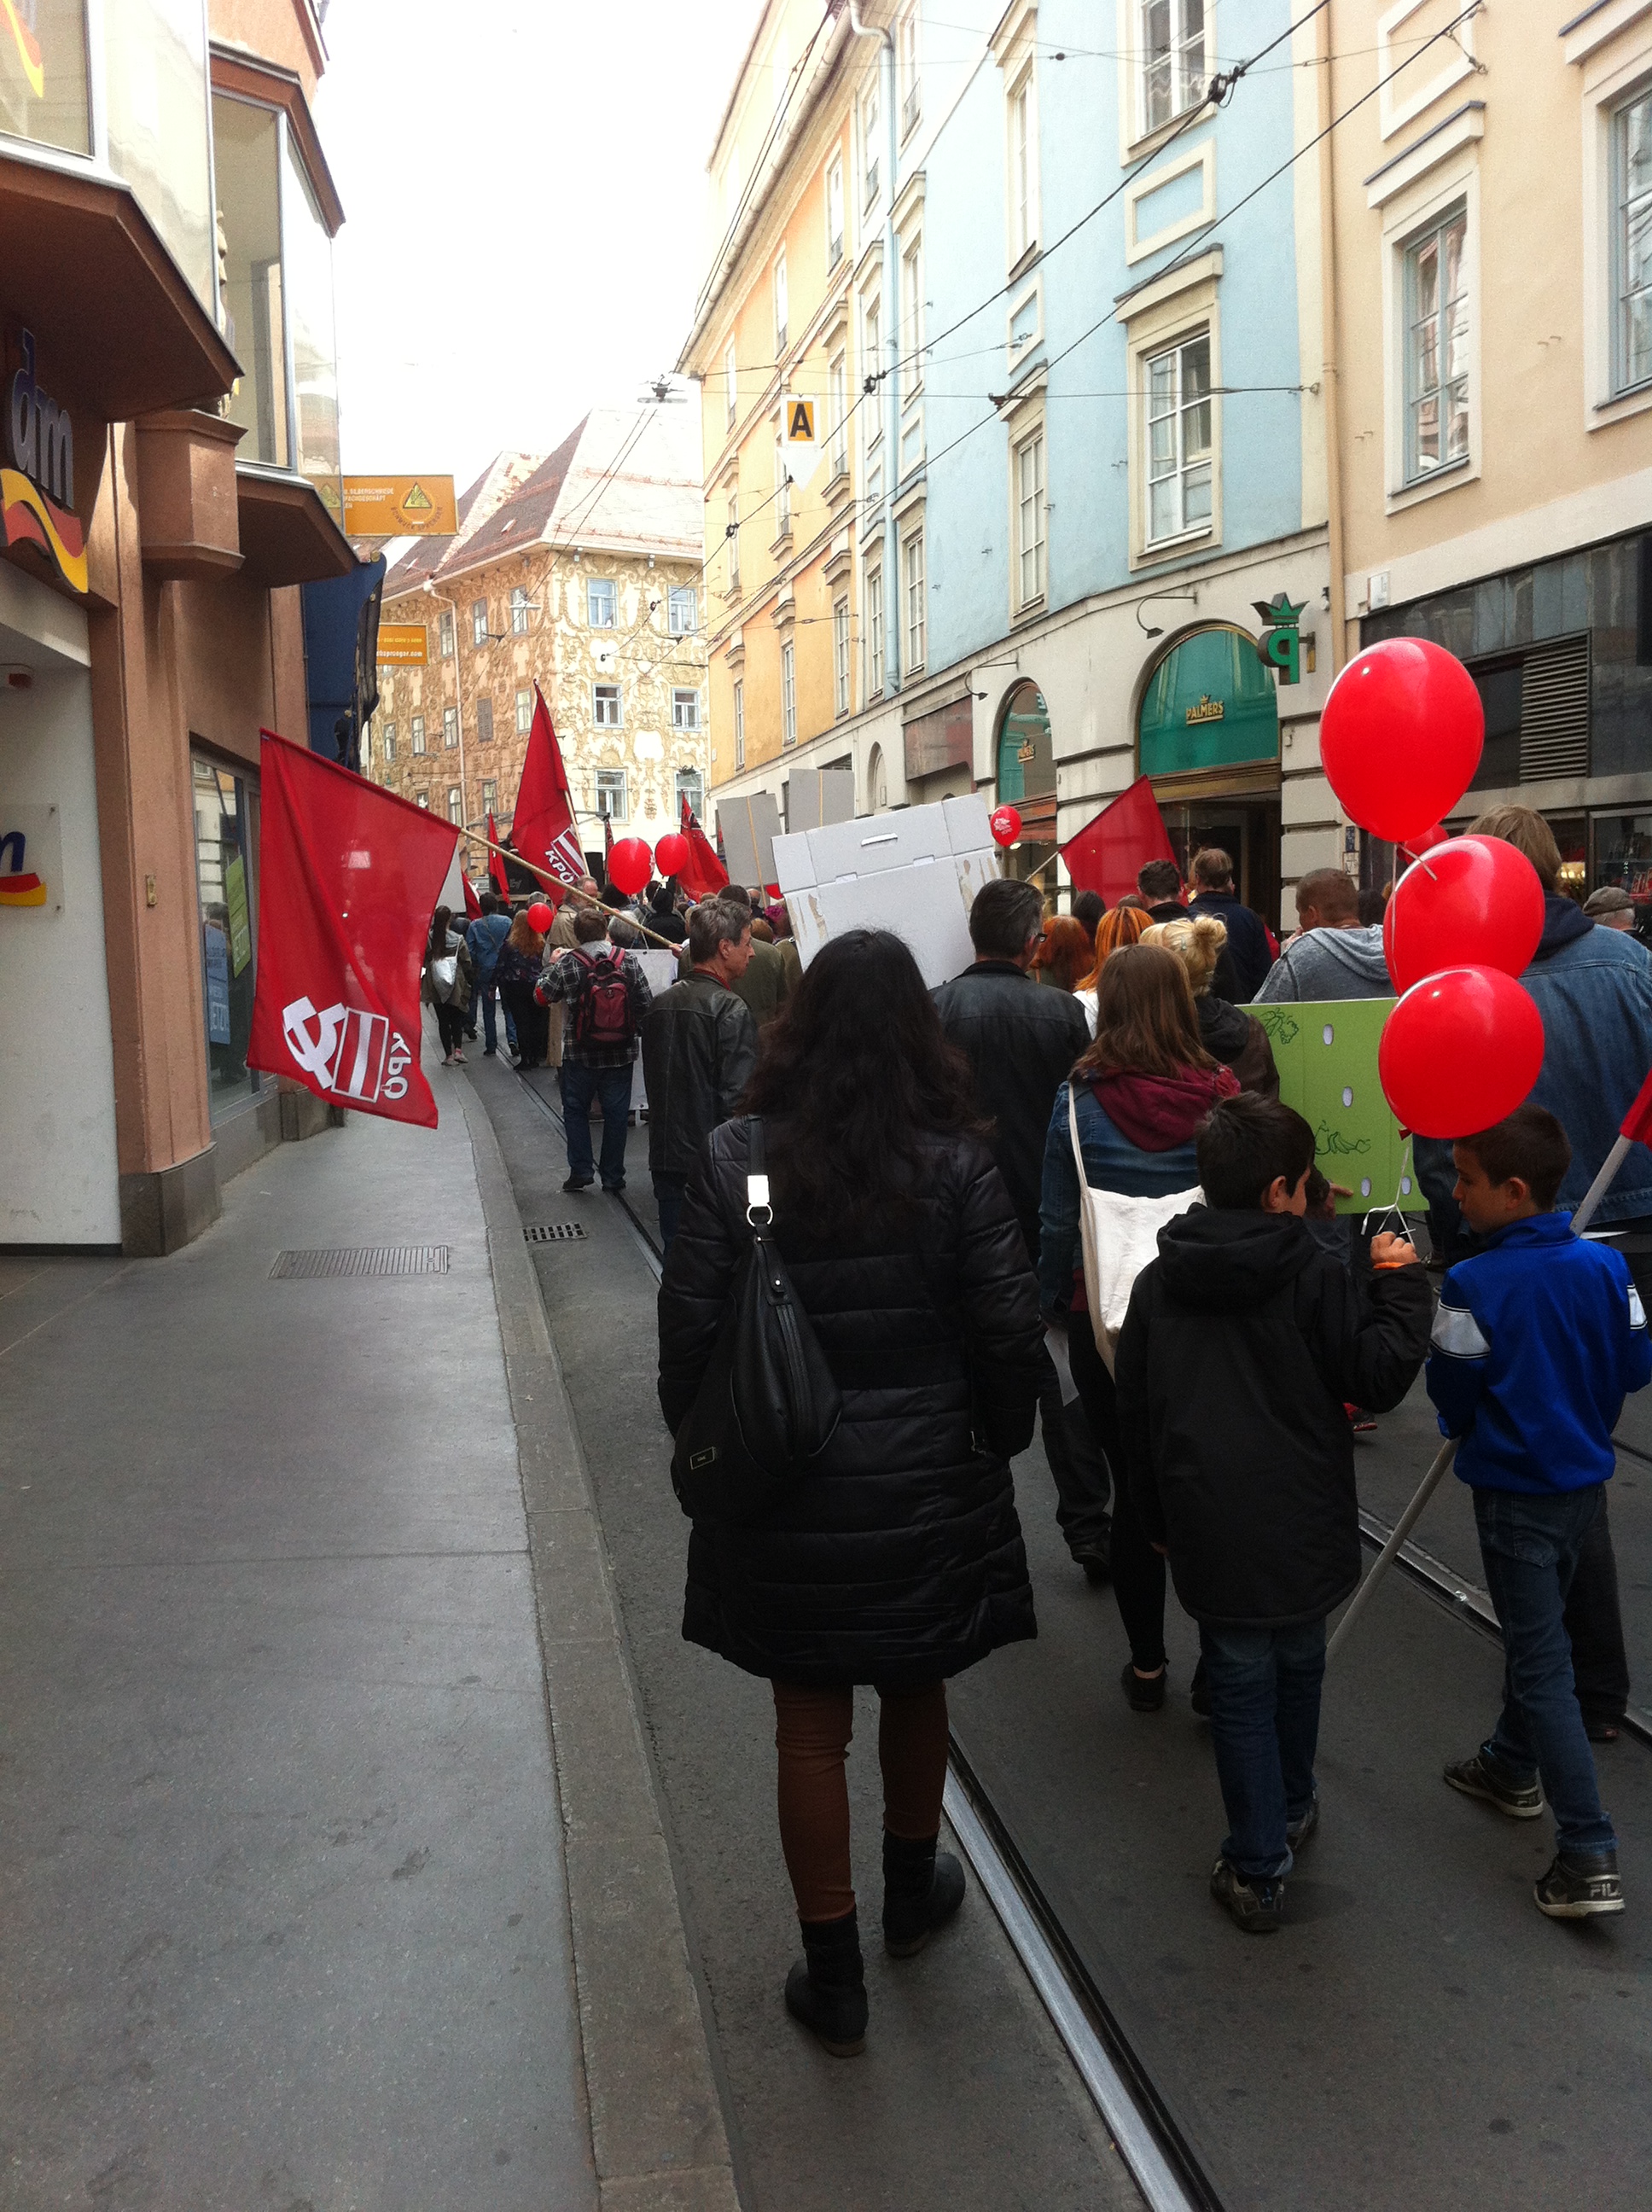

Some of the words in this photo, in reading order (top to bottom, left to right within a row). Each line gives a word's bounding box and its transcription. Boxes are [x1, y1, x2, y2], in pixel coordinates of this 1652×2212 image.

[12, 328, 74, 509] dm
[789, 404, 812, 437] A
[1186, 700, 1224, 720] PALMERS
